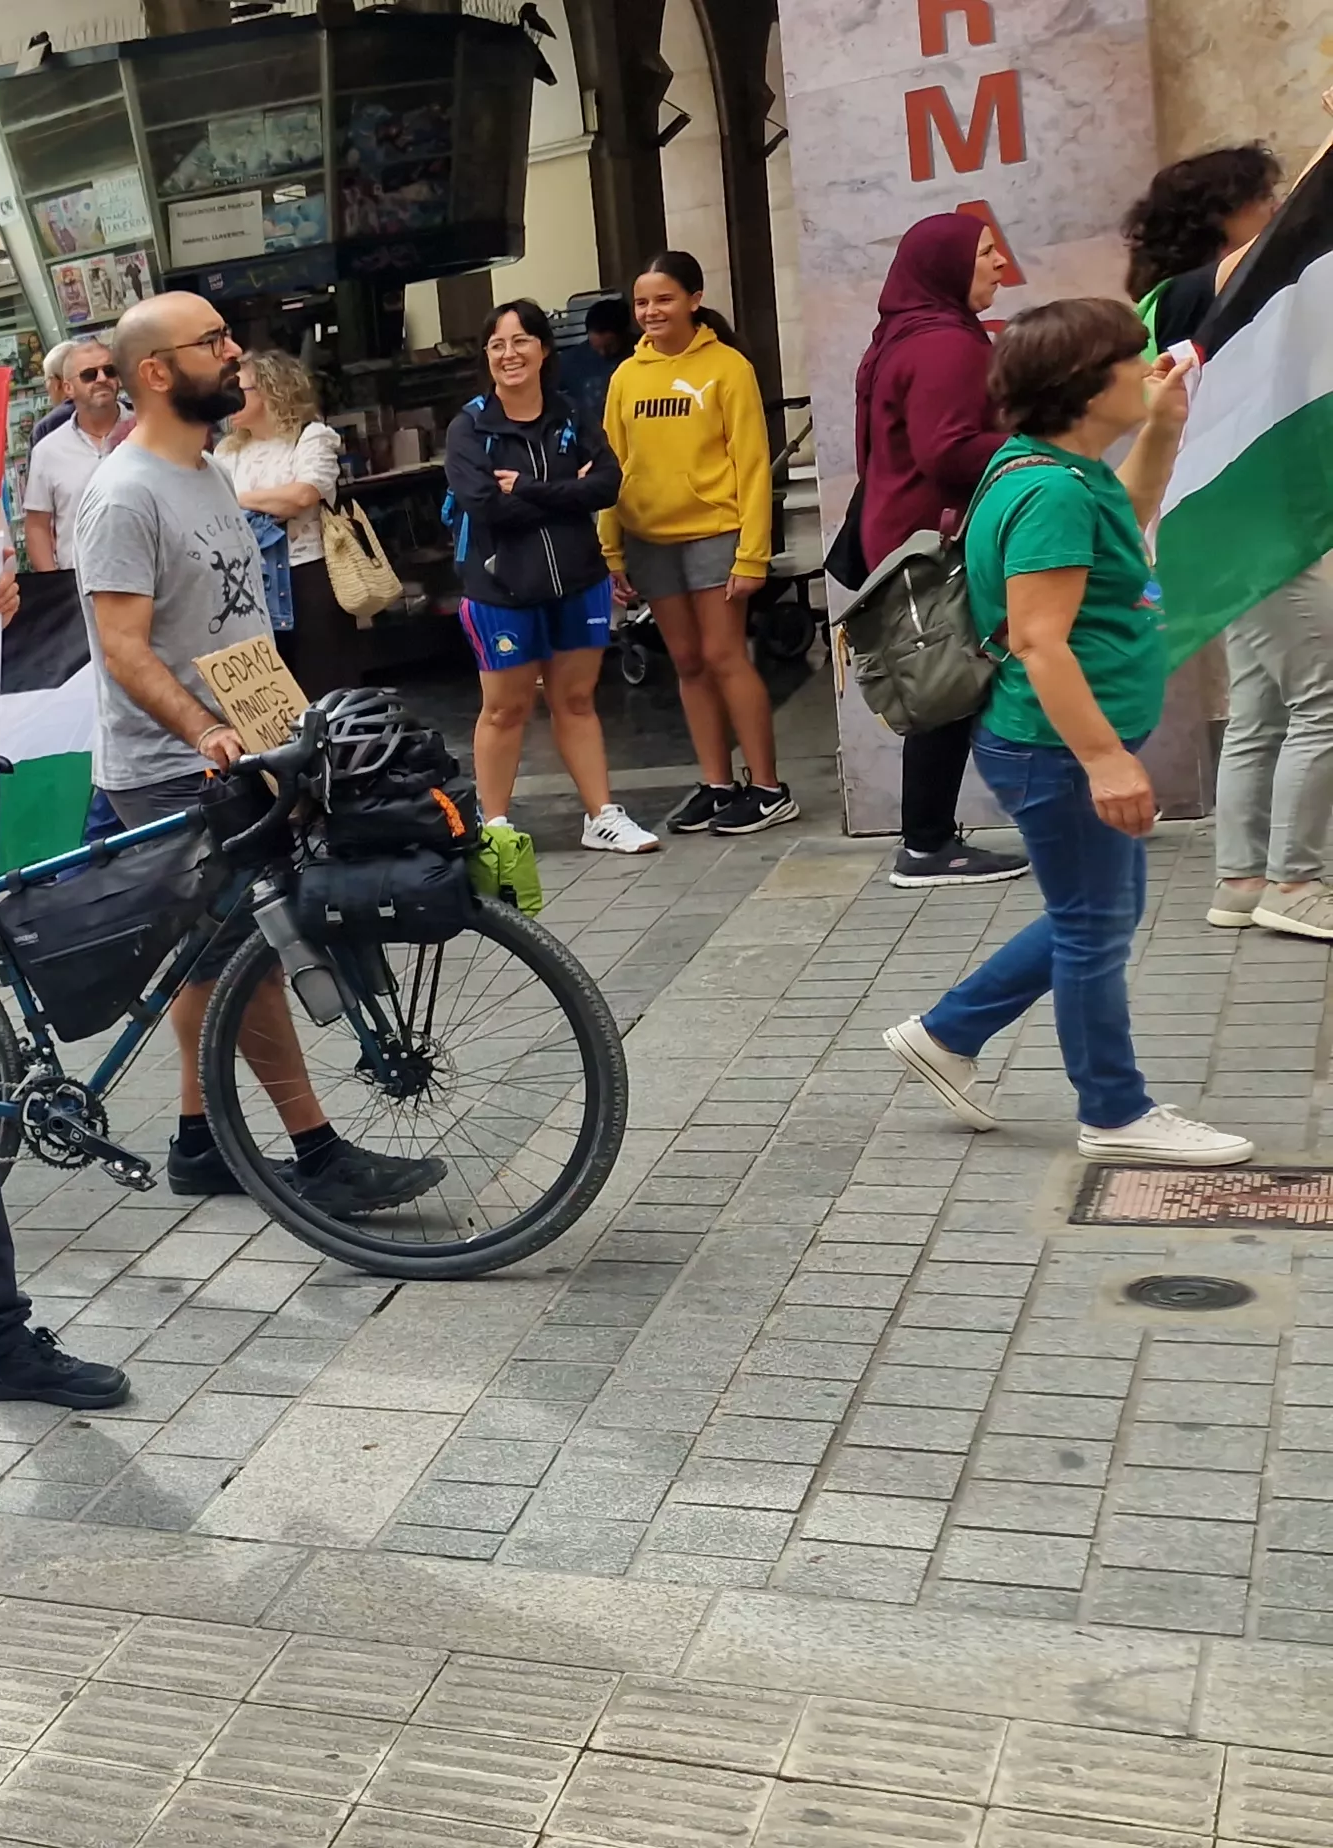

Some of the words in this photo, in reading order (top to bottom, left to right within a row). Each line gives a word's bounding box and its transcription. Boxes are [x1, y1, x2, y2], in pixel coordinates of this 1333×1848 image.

[634, 397, 691, 420] PUMA
[210, 651, 263, 693] CADA
[230, 680, 290, 728] MINUTOS
